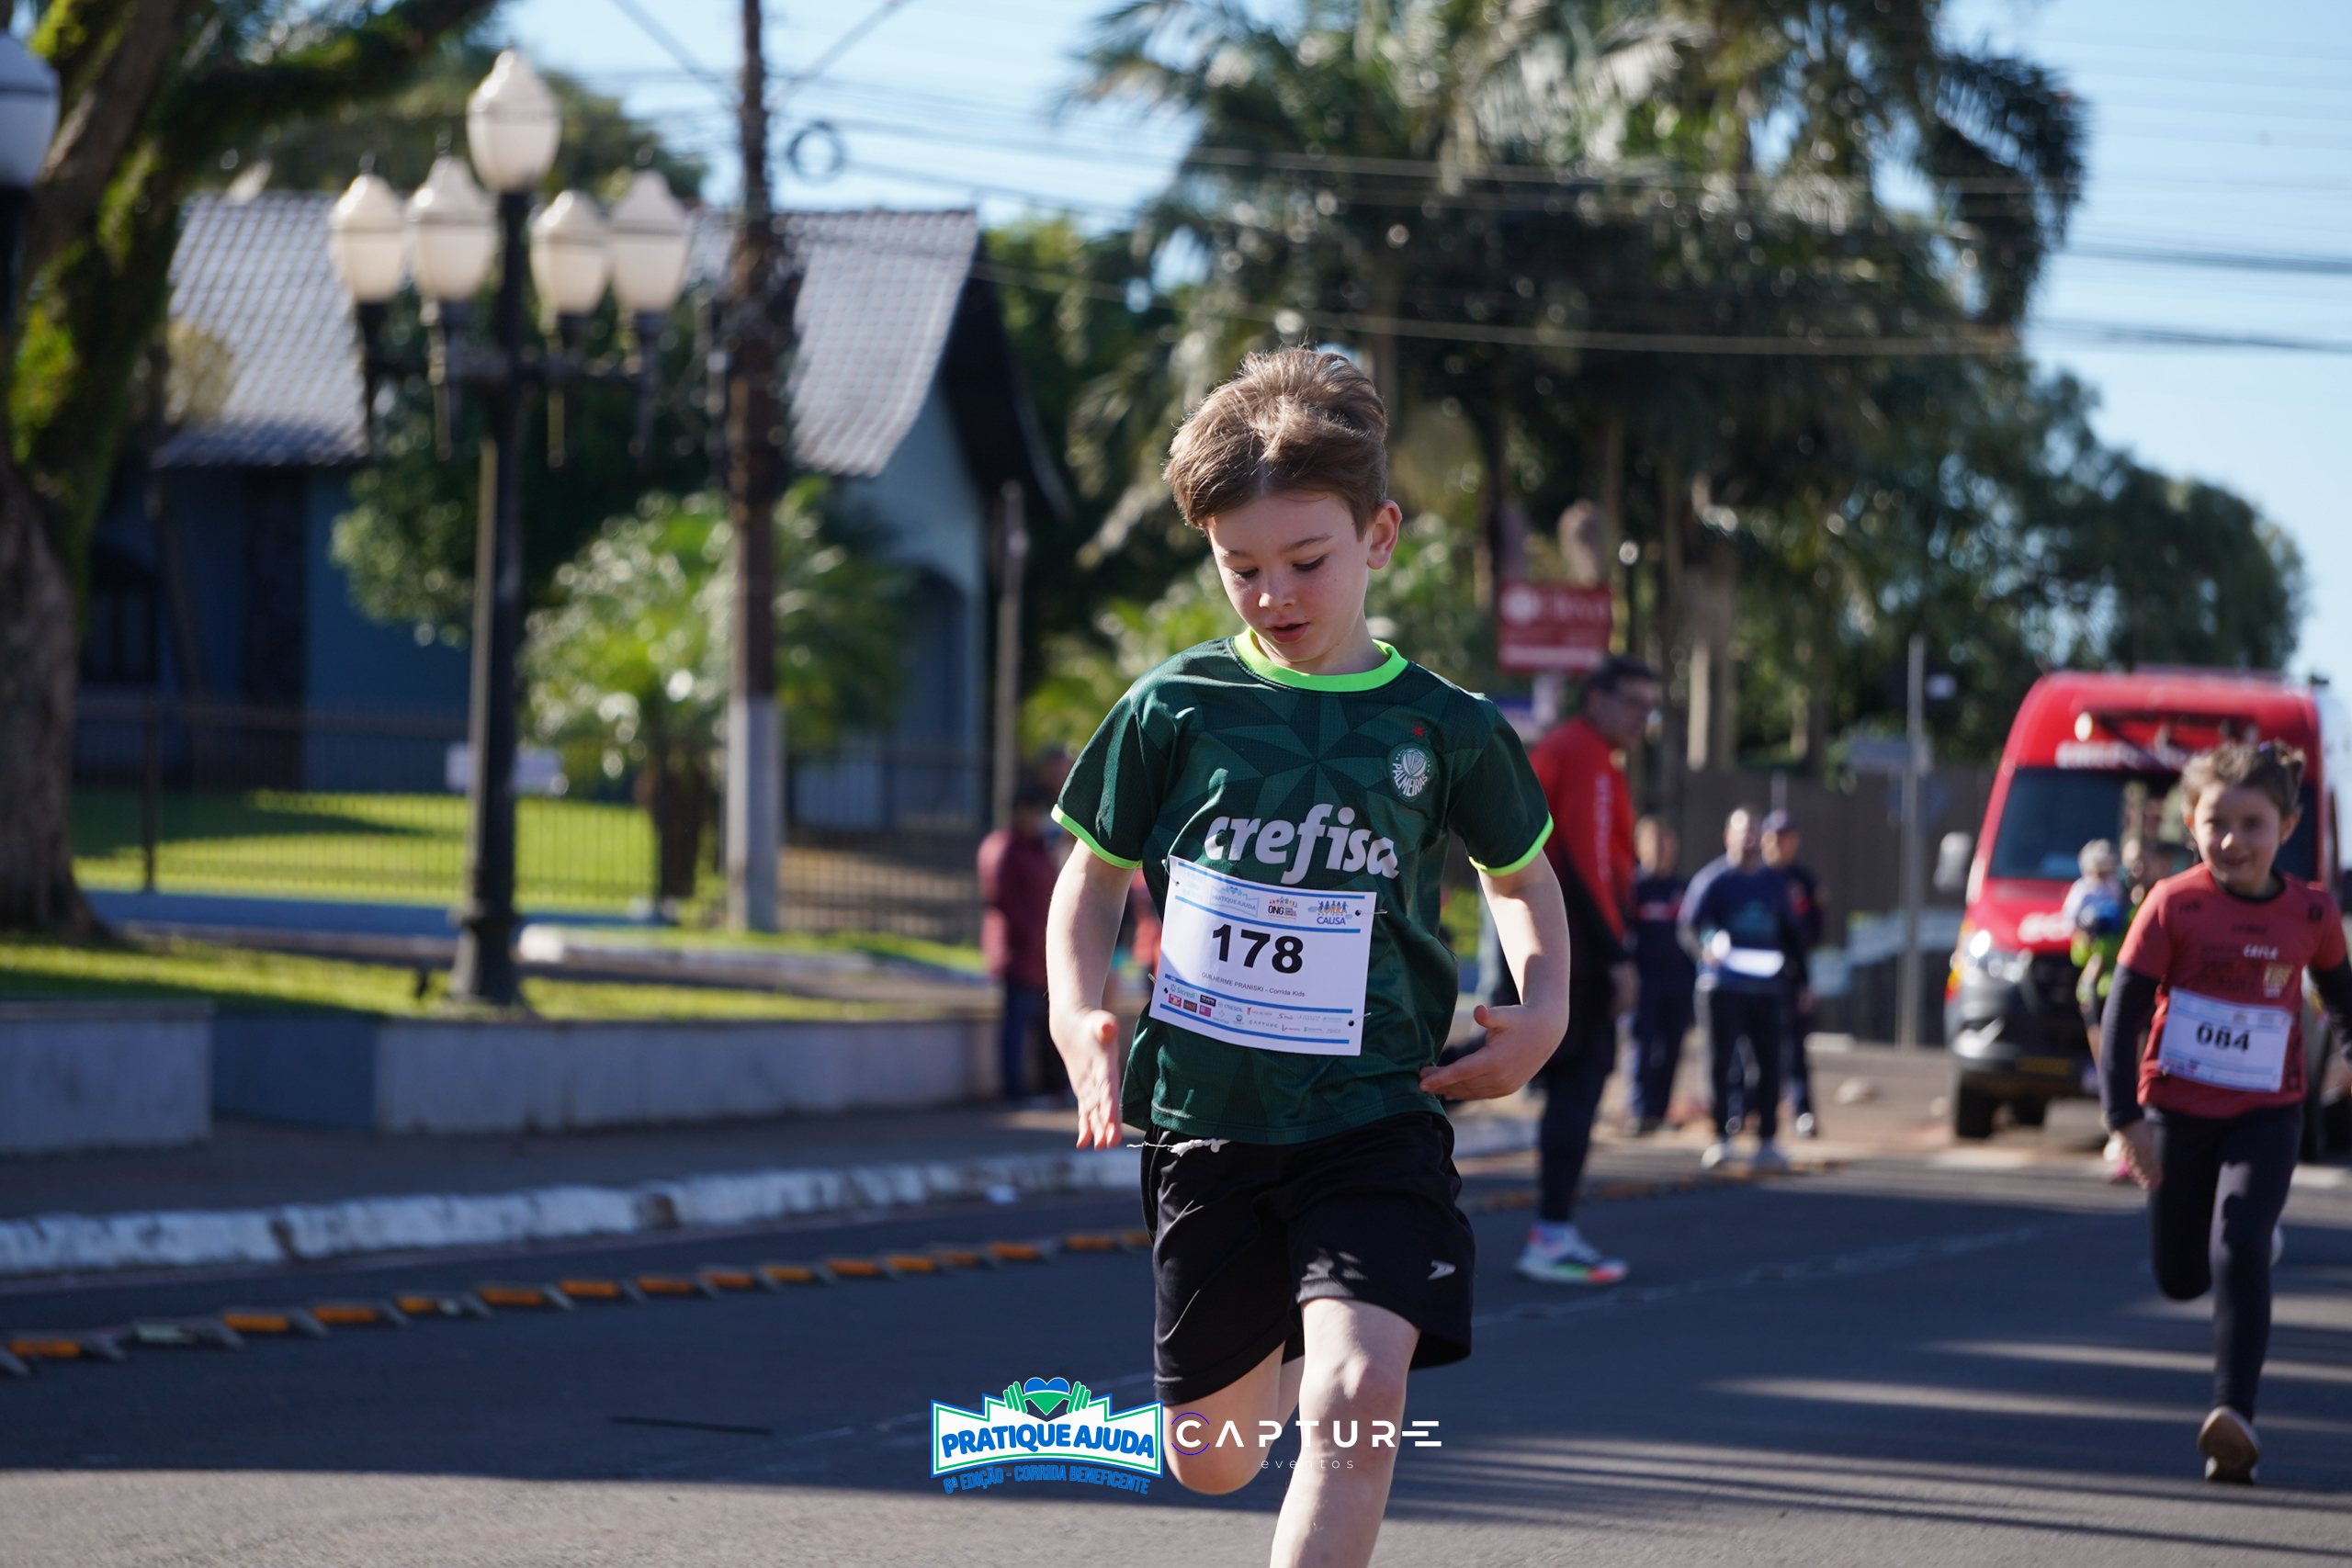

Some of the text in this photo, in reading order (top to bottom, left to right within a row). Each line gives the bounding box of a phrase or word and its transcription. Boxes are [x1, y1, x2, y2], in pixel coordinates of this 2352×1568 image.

[1392, 762, 1428, 797] PALMEIRAS
[1204, 803, 1399, 885] crefisa
[1237, 900, 1256, 910] AJUDA
[1268, 905, 1284, 915] ONG
[1317, 916, 1346, 925] CAUSA
[1212, 923, 1304, 974] 178
[1201, 972, 1234, 987] GUILHERME
[1234, 981, 1264, 992] PRANISKI
[1269, 987, 1291, 996] Corrida
[2195, 1021, 2251, 1053] 084
